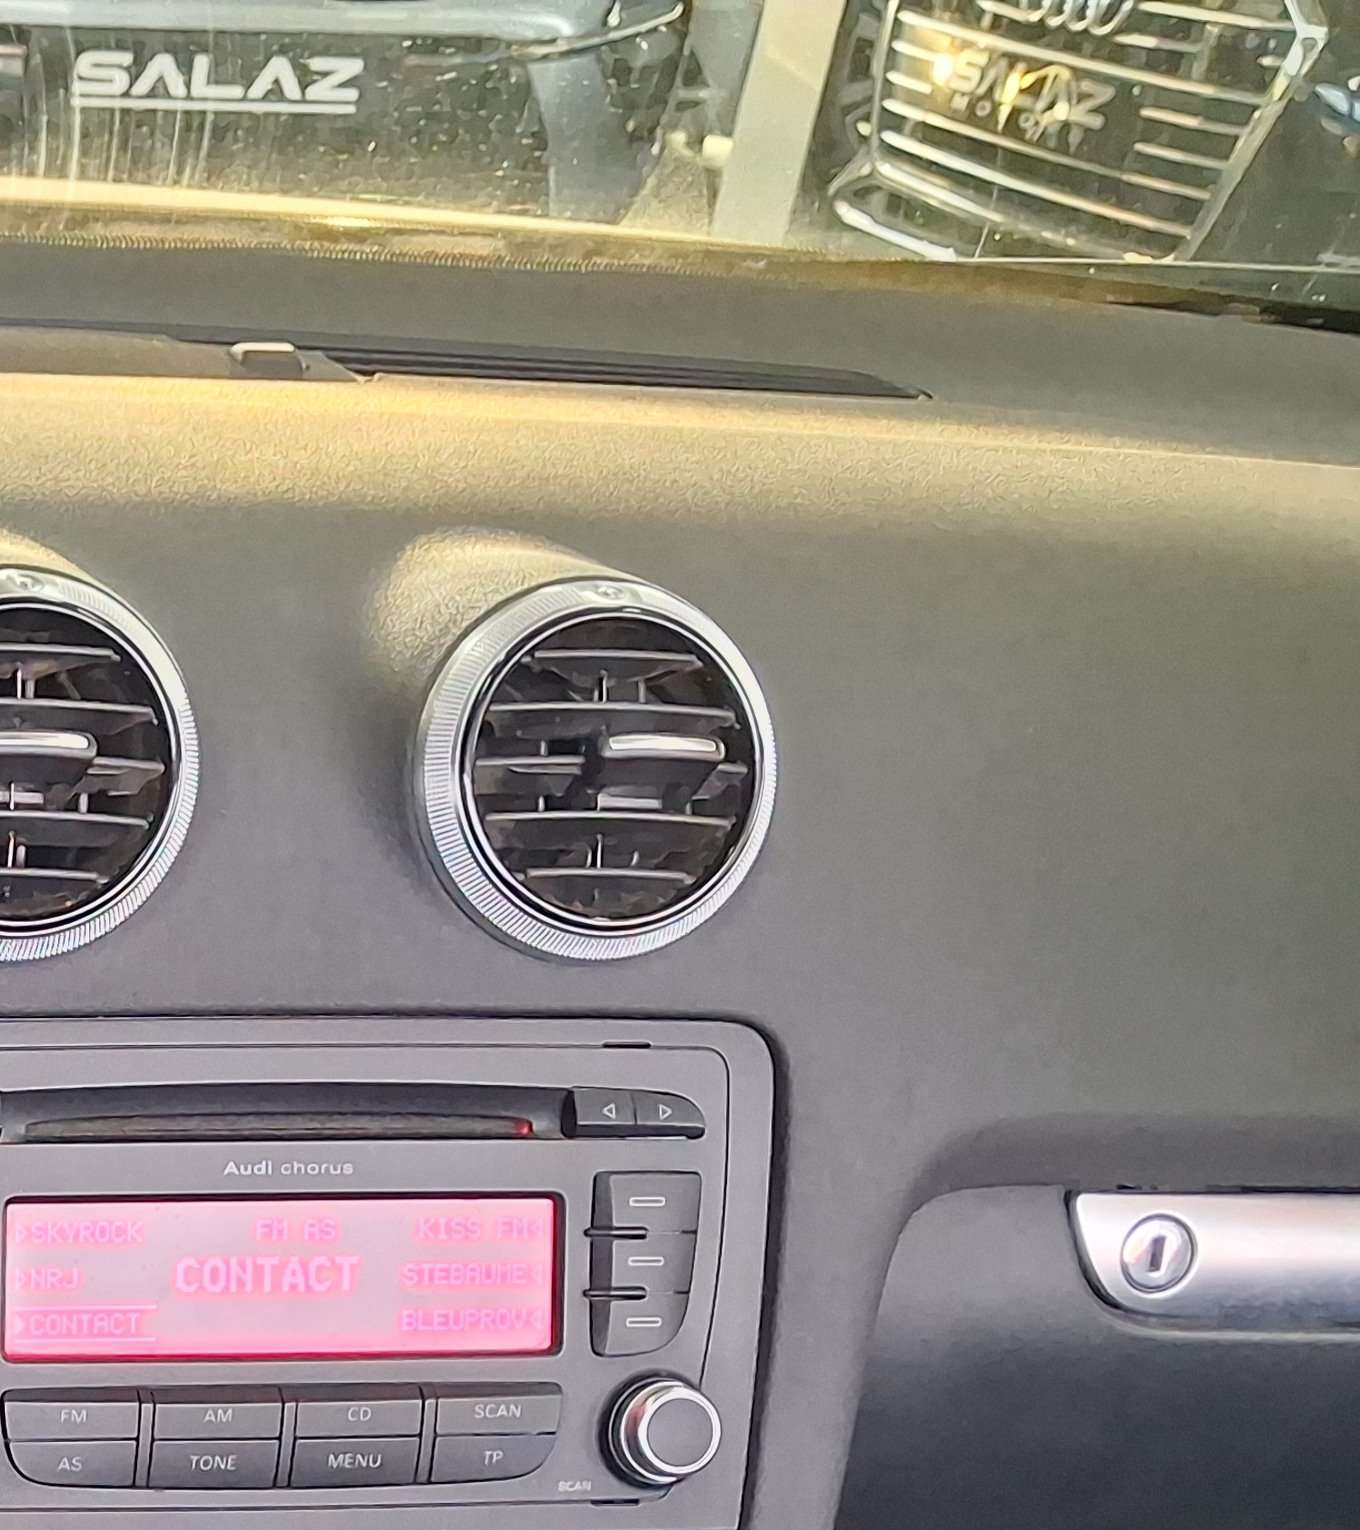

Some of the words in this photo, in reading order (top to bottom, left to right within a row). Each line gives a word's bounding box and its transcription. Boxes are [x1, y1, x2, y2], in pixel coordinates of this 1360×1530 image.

[71, 50, 364, 102] SALAZ
[223, 1160, 273, 1176] Audi
[280, 1161, 354, 1176] chorus
[31, 1219, 145, 1244] SKYROCK
[255, 1218, 289, 1241] FM
[303, 1217, 337, 1241] AS
[418, 1216, 481, 1240] KISS
[496, 1216, 529, 1239] FM
[31, 1267, 80, 1290] NRJ
[175, 1255, 360, 1294] CONTACT
[31, 1312, 141, 1336] CONTACT
[60, 1408, 88, 1425] FM
[203, 1407, 234, 1424] AM
[347, 1406, 373, 1423] CD
[473, 1402, 523, 1420] SCAN
[57, 1455, 84, 1473] AS
[189, 1454, 238, 1473] TONE
[327, 1452, 383, 1471] MENU
[483, 1449, 504, 1467] TP
[557, 1480, 592, 1492] SCAN
